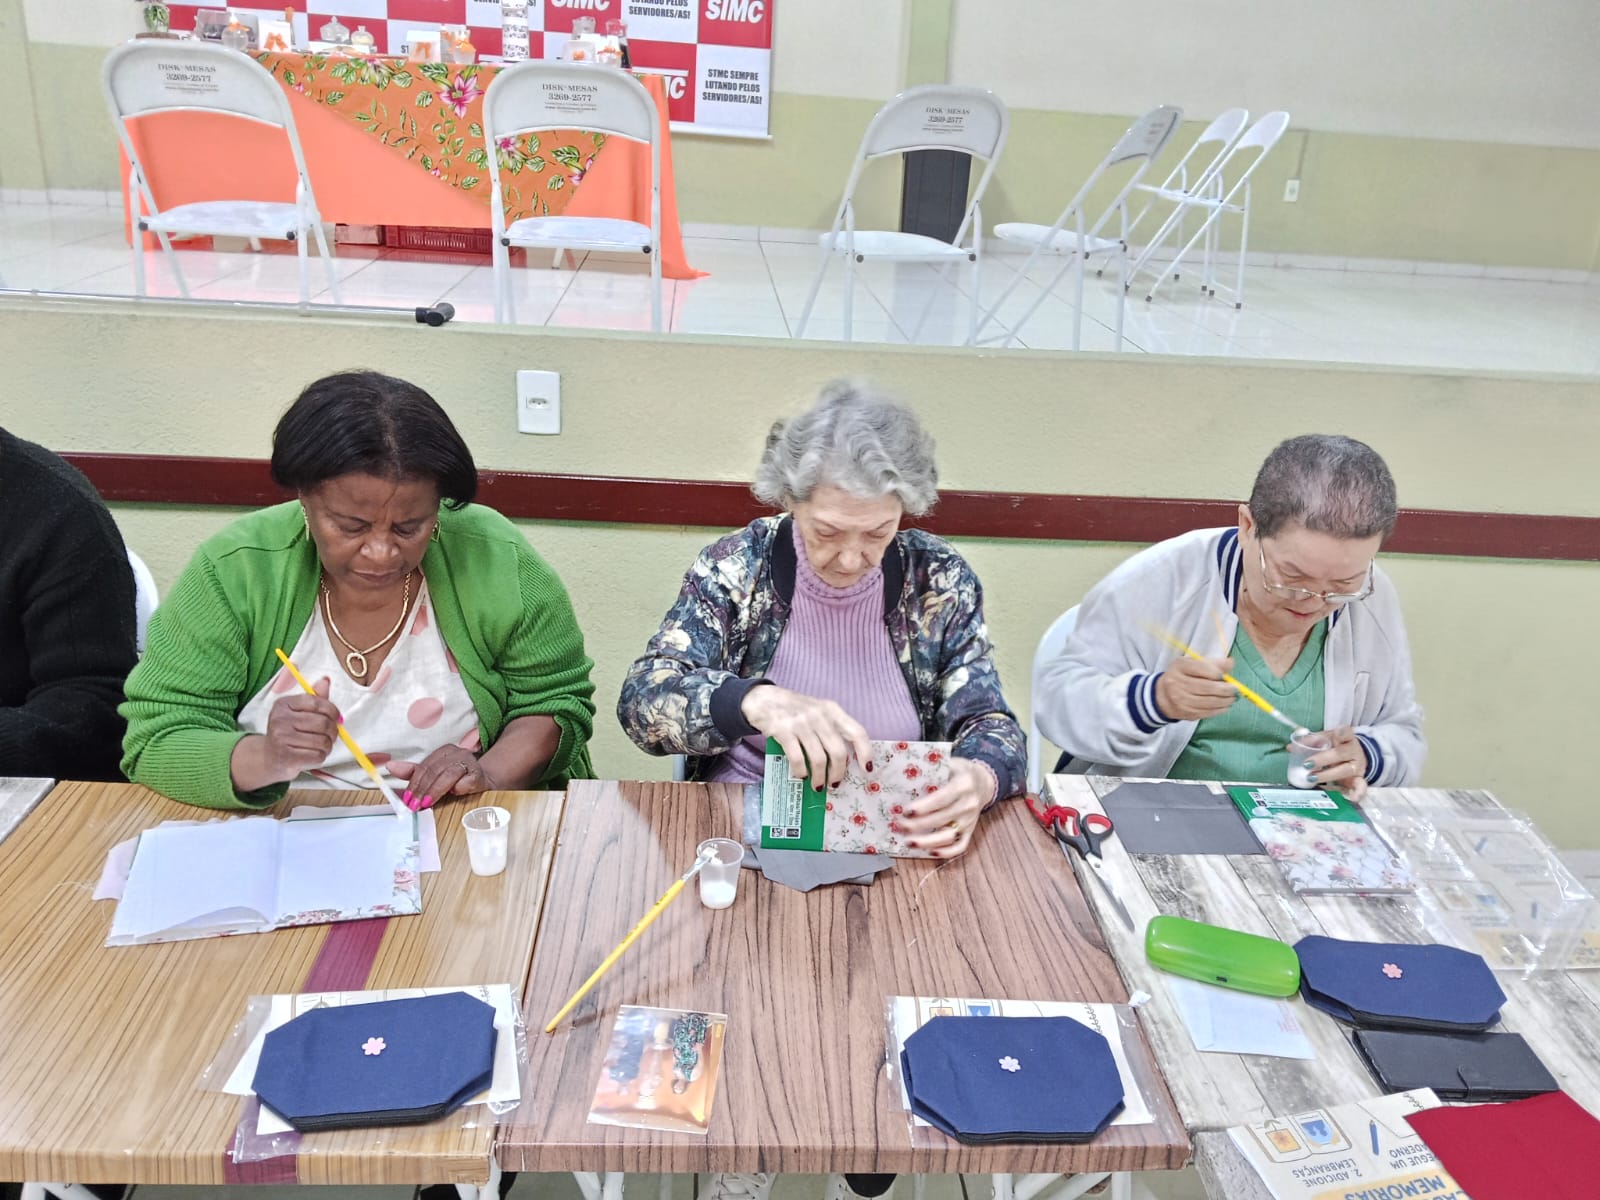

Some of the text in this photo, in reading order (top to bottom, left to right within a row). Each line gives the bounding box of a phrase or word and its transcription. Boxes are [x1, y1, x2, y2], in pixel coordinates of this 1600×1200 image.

[628, 5, 691, 19] SERVIDORES/AS!
[707, 68, 759, 81] STMC SEMPRE
[705, 80, 760, 93] LUTANDO PELOS
[702, 92, 763, 105] SERVIDORES/AS!
[1389, 1143, 1433, 1158] ADERNO
[1292, 1158, 1357, 1179] LEMBRANÇAS
[1389, 1153, 1439, 1170] EGUE UM
[1302, 1168, 1363, 1188] 2. ADICIONE
